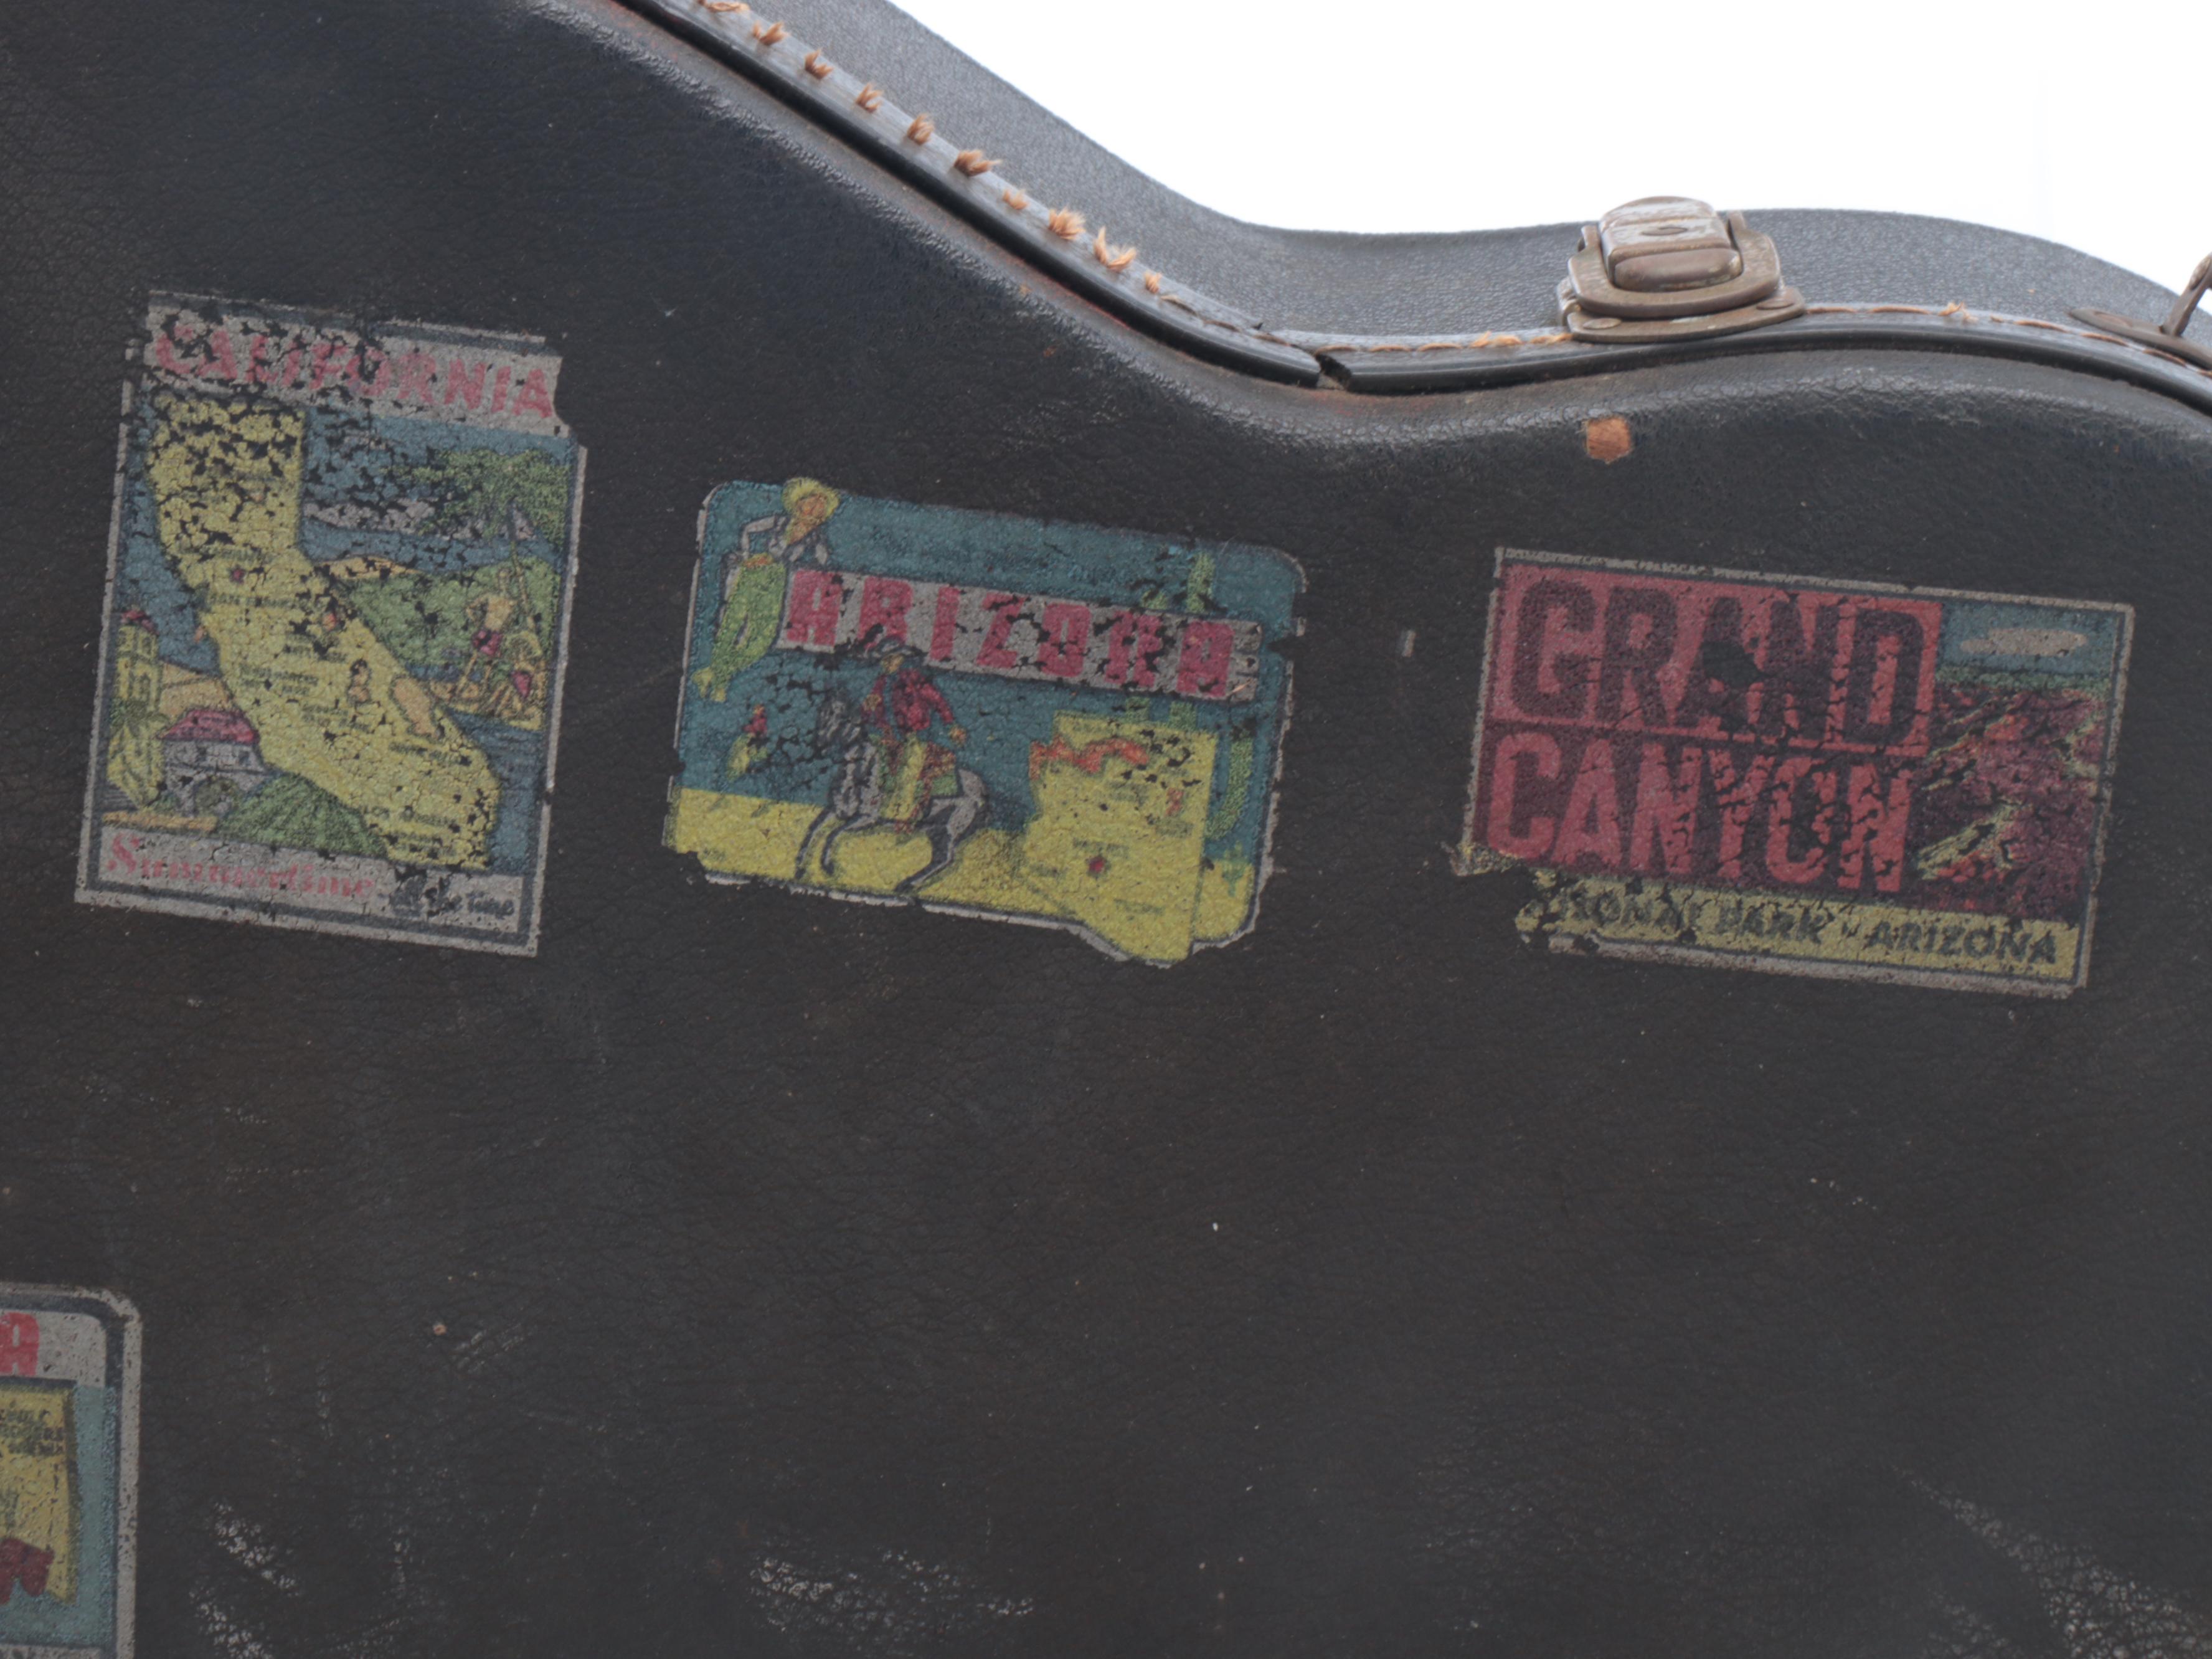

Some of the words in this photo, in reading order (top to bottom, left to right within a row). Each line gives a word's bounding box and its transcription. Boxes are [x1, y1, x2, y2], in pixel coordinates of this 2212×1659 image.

[154, 326, 554, 418] CALIFORNIA
[786, 568, 1235, 699] ARIZONA
[1510, 578, 1926, 749] GRAND
[1487, 731, 1913, 893] CANYON
[1866, 919, 2055, 964] ARIZONA
